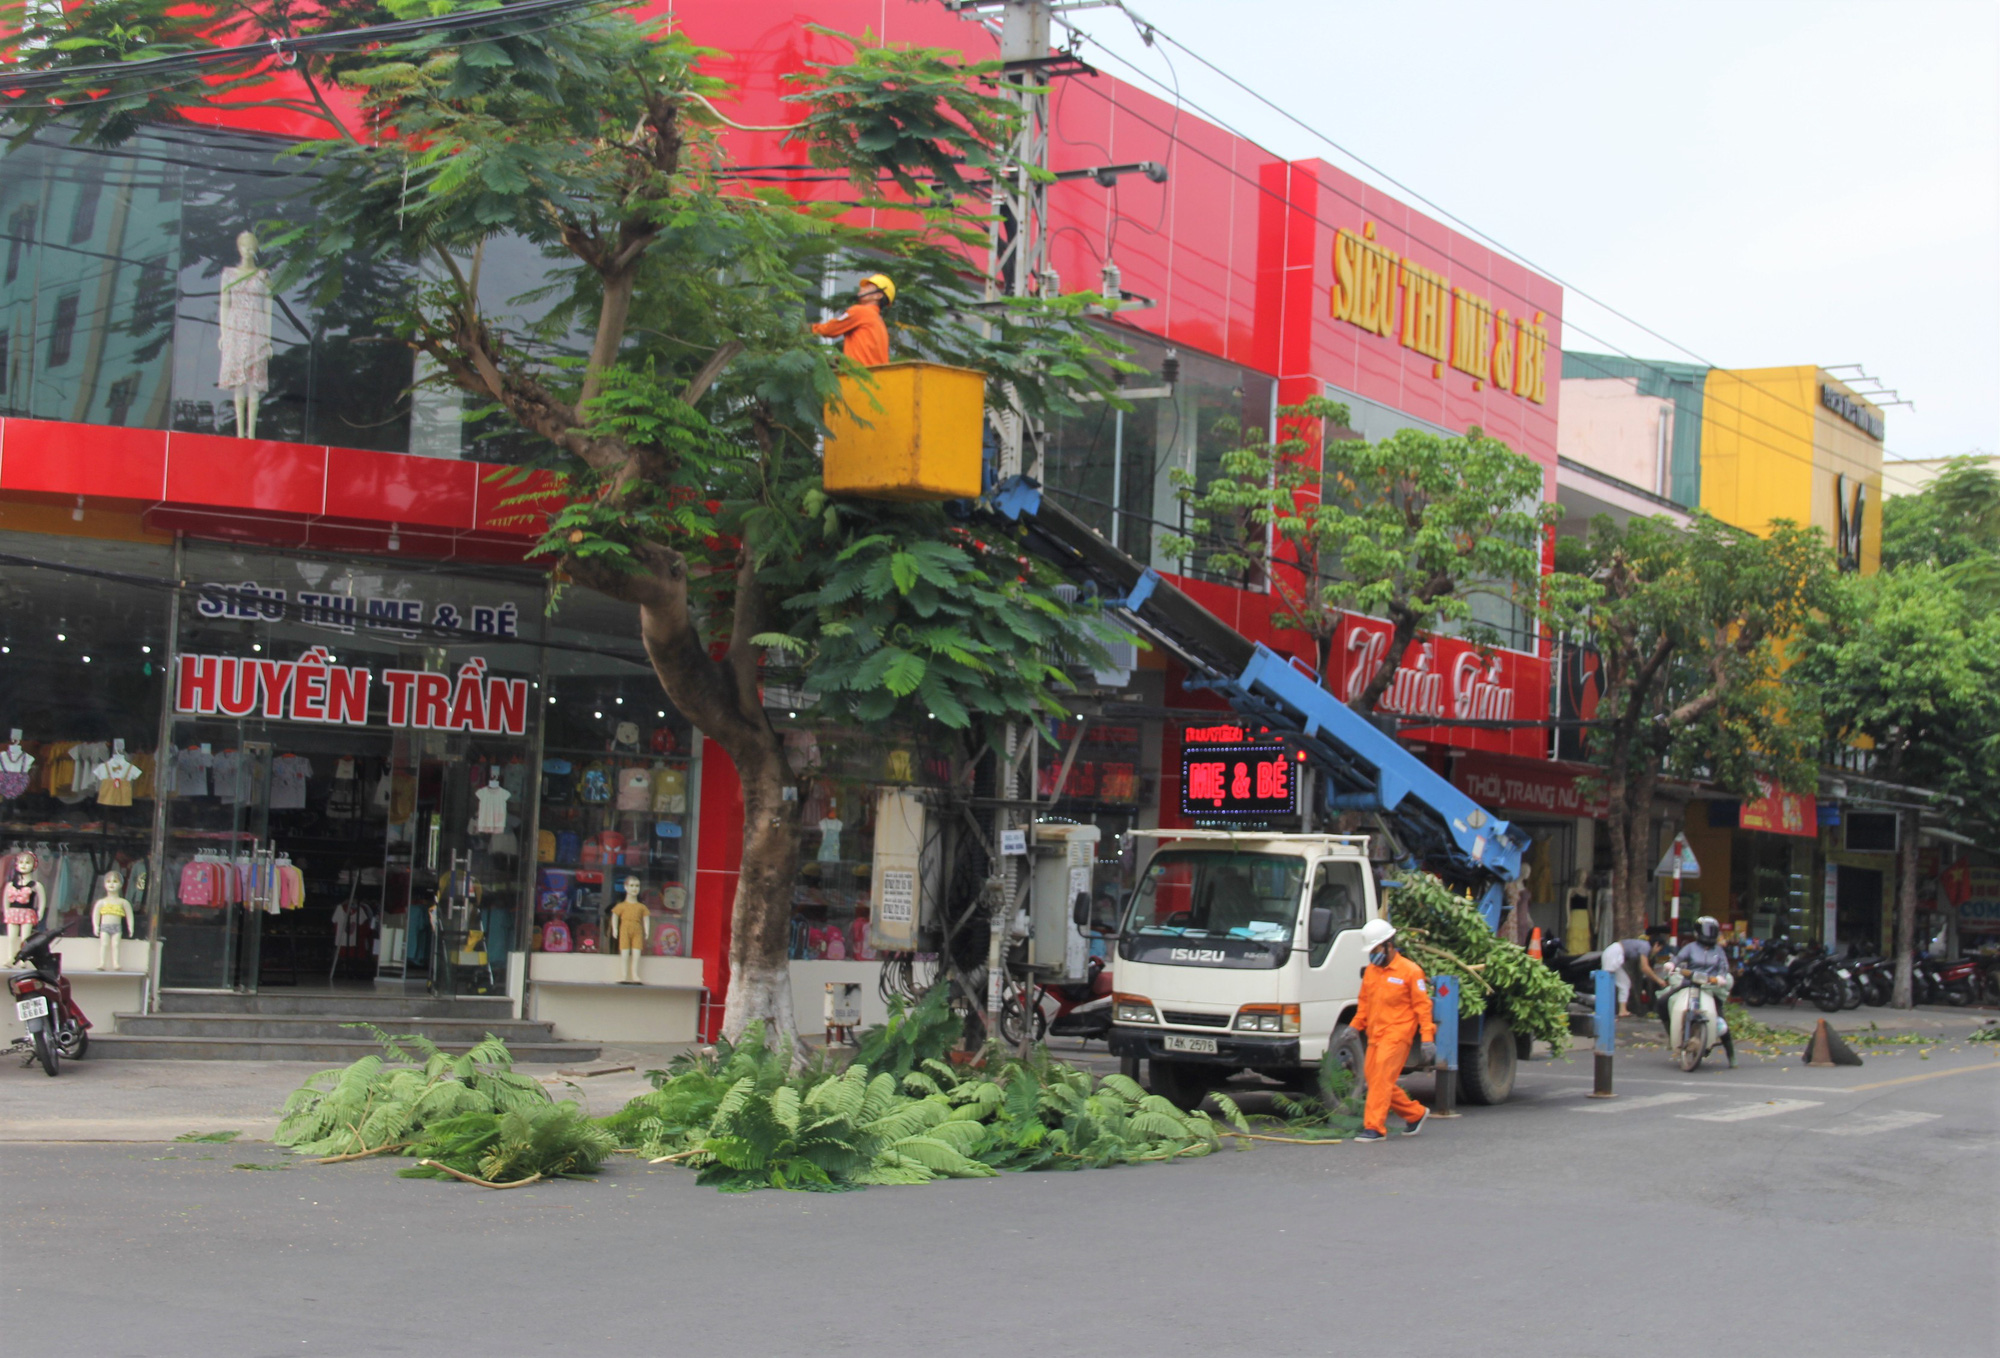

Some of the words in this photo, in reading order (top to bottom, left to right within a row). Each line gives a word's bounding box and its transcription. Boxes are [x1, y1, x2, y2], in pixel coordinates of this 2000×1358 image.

[1330, 220, 1399, 338] SIÊU
[1399, 257, 1449, 379] THỊ
[1449, 287, 1491, 392] MẸ
[1491, 308, 1512, 390] &
[1513, 311, 1548, 405] BÉ
[198, 581, 286, 623] SIÊU
[298, 591, 357, 634] THỊ
[366, 597, 422, 638] MẸ
[432, 603, 462, 637] &
[471, 603, 518, 639] BÉ
[175, 645, 370, 725] HUYỀN
[383, 656, 528, 735] TRẦN
[1189, 762, 1226, 807] MẸ
[1231, 762, 1251, 799] &
[1257, 754, 1288, 798] BÉ
[1171, 948, 1225, 962] ISUZU
[1168, 1036, 1186, 1049] 74K
[1189, 1038, 1215, 1052] 2576
